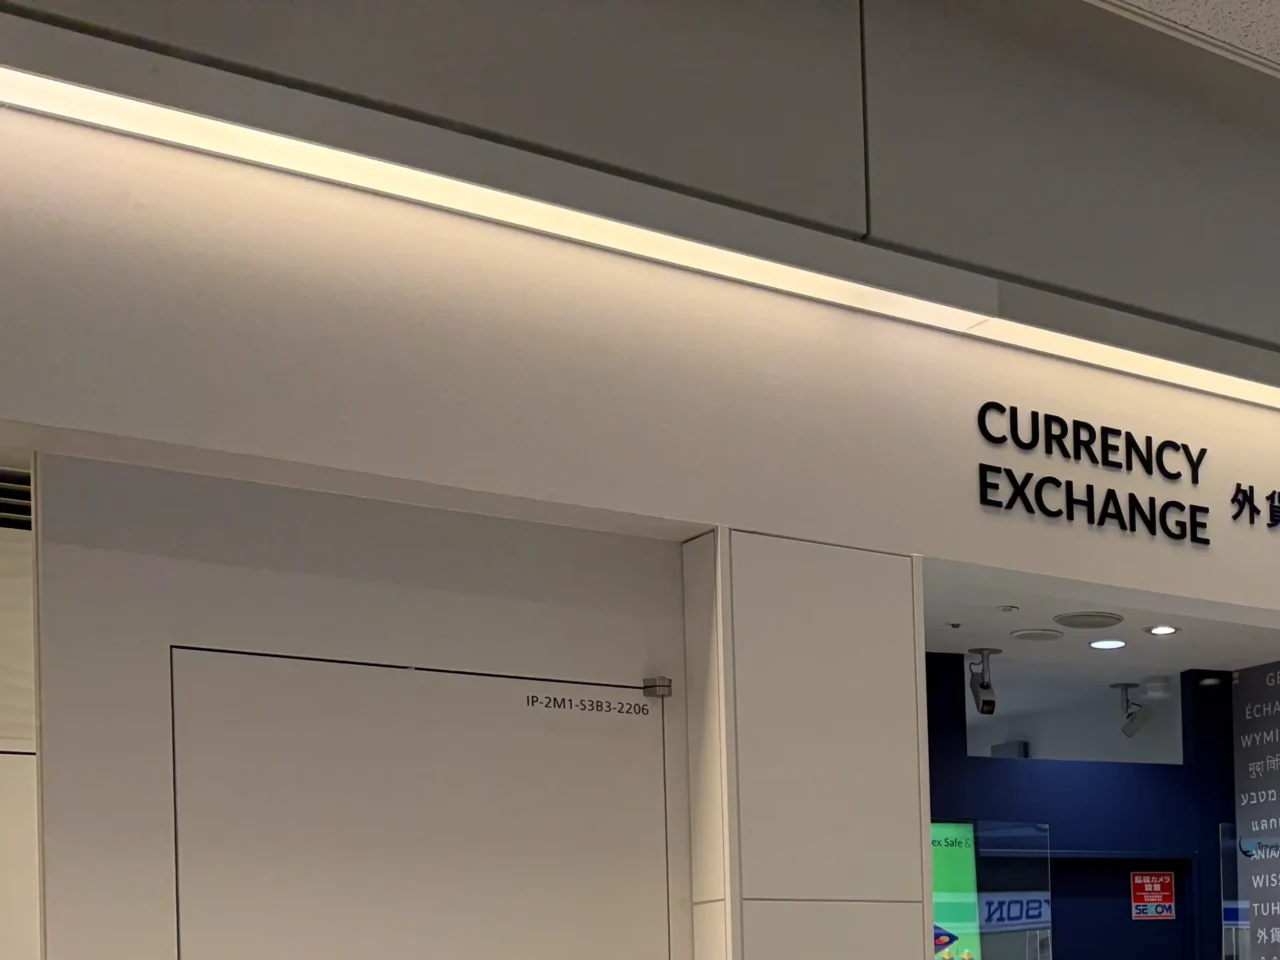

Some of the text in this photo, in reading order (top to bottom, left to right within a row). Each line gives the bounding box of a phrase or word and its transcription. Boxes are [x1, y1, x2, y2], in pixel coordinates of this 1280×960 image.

[977, 401, 1207, 486] CURRENCY
[978, 463, 1210, 546] EXCHANGE
[526, 695, 649, 715] IP-2M1-S3B3-2206
[1240, 789, 1277, 806] מטבע
[944, 838, 963, 848] Safe
[1135, 904, 1172, 915] SECOM
